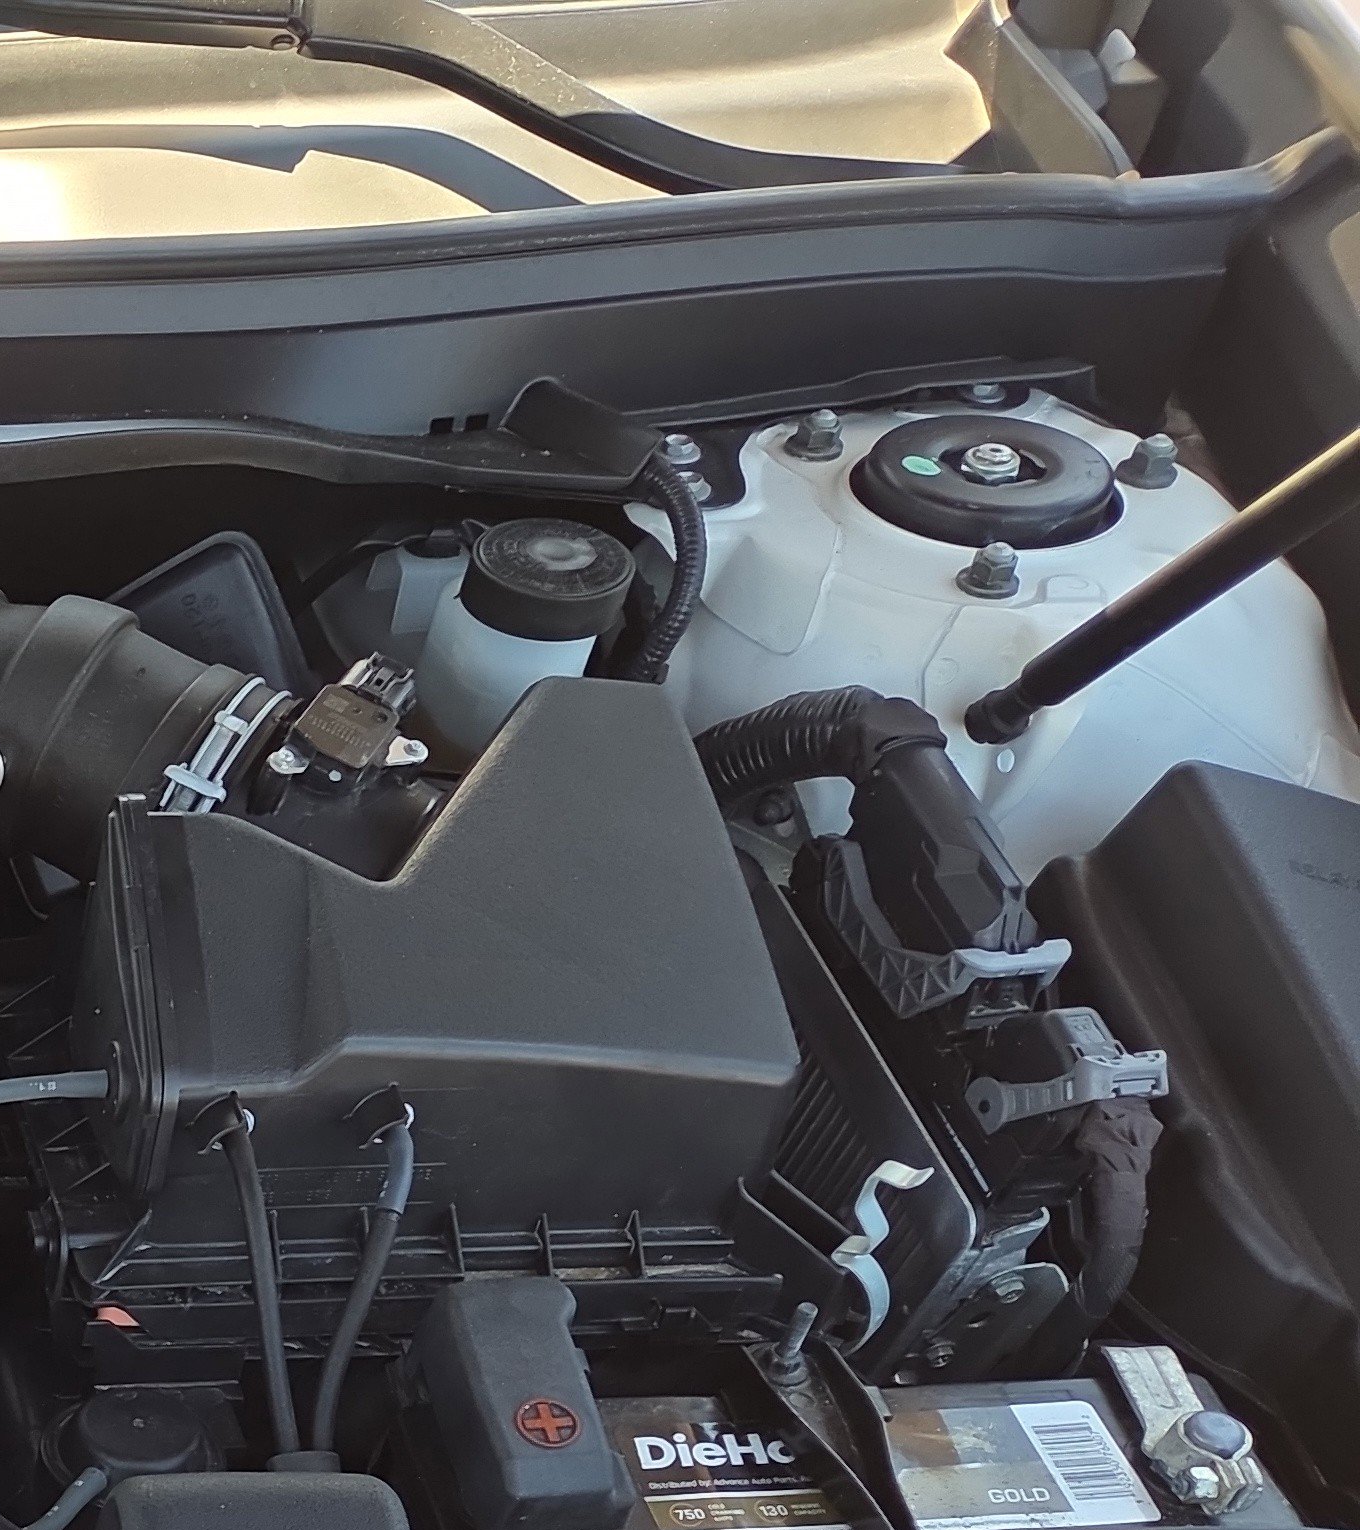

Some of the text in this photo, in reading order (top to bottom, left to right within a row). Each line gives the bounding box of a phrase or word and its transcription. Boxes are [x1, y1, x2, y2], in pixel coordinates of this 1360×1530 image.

[713, 1477, 750, 1487] Advance
[752, 1476, 771, 1485] Auto
[988, 1486, 1050, 1504] GOLD
[673, 1508, 706, 1521] 750
